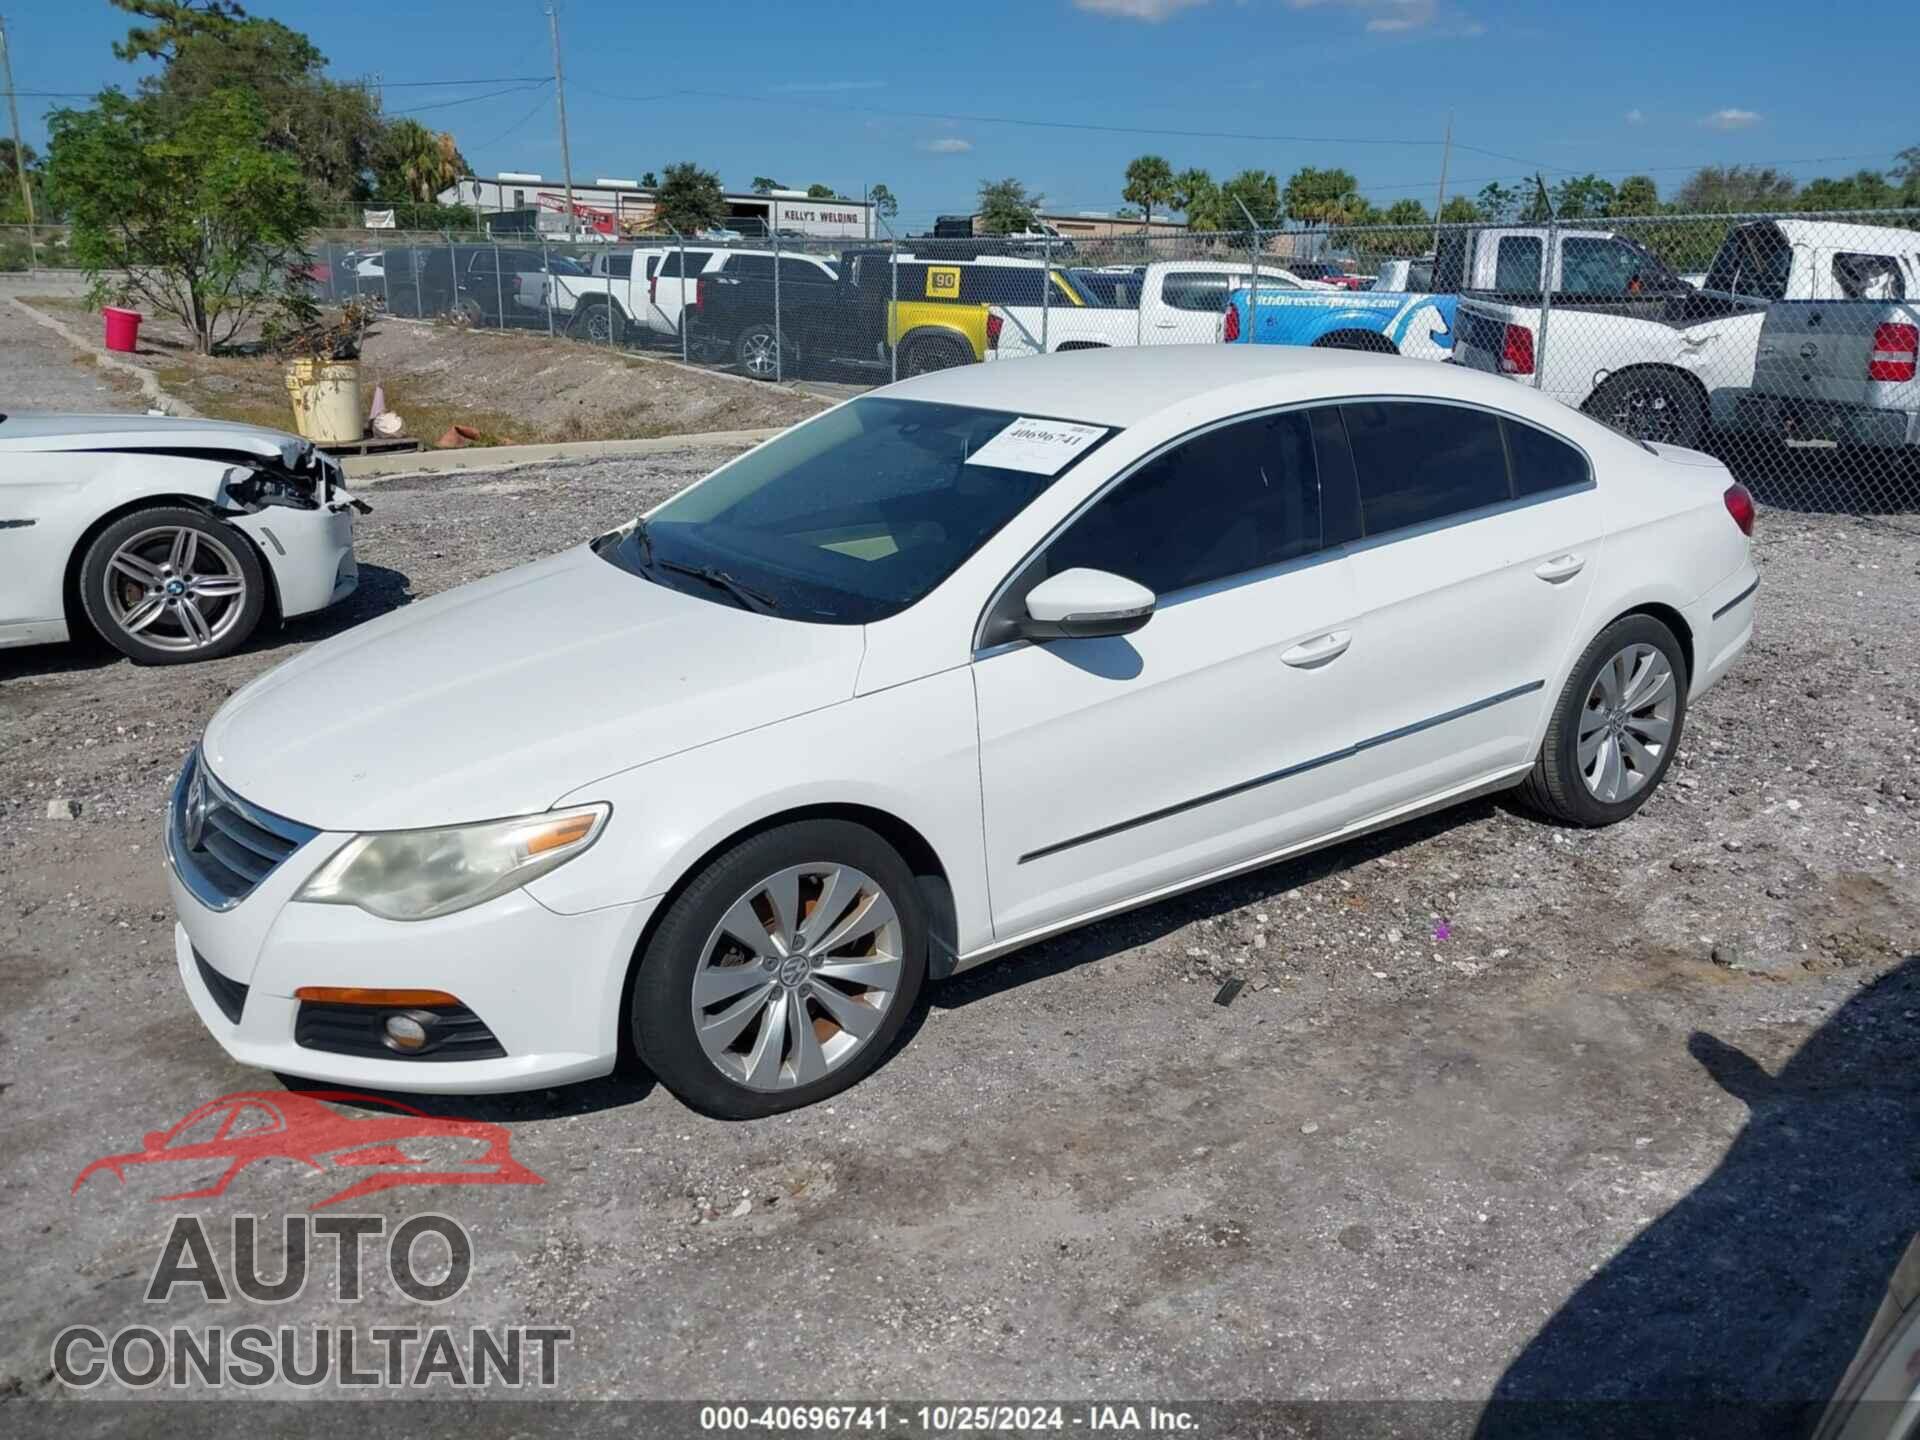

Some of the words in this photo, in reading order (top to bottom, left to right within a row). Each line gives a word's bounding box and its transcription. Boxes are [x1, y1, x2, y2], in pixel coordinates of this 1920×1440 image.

[784, 210, 816, 222] KELLY'S
[820, 212, 858, 224] WELDING
[936, 274, 955, 287] 90
[1011, 427, 1083, 446] 40696741
